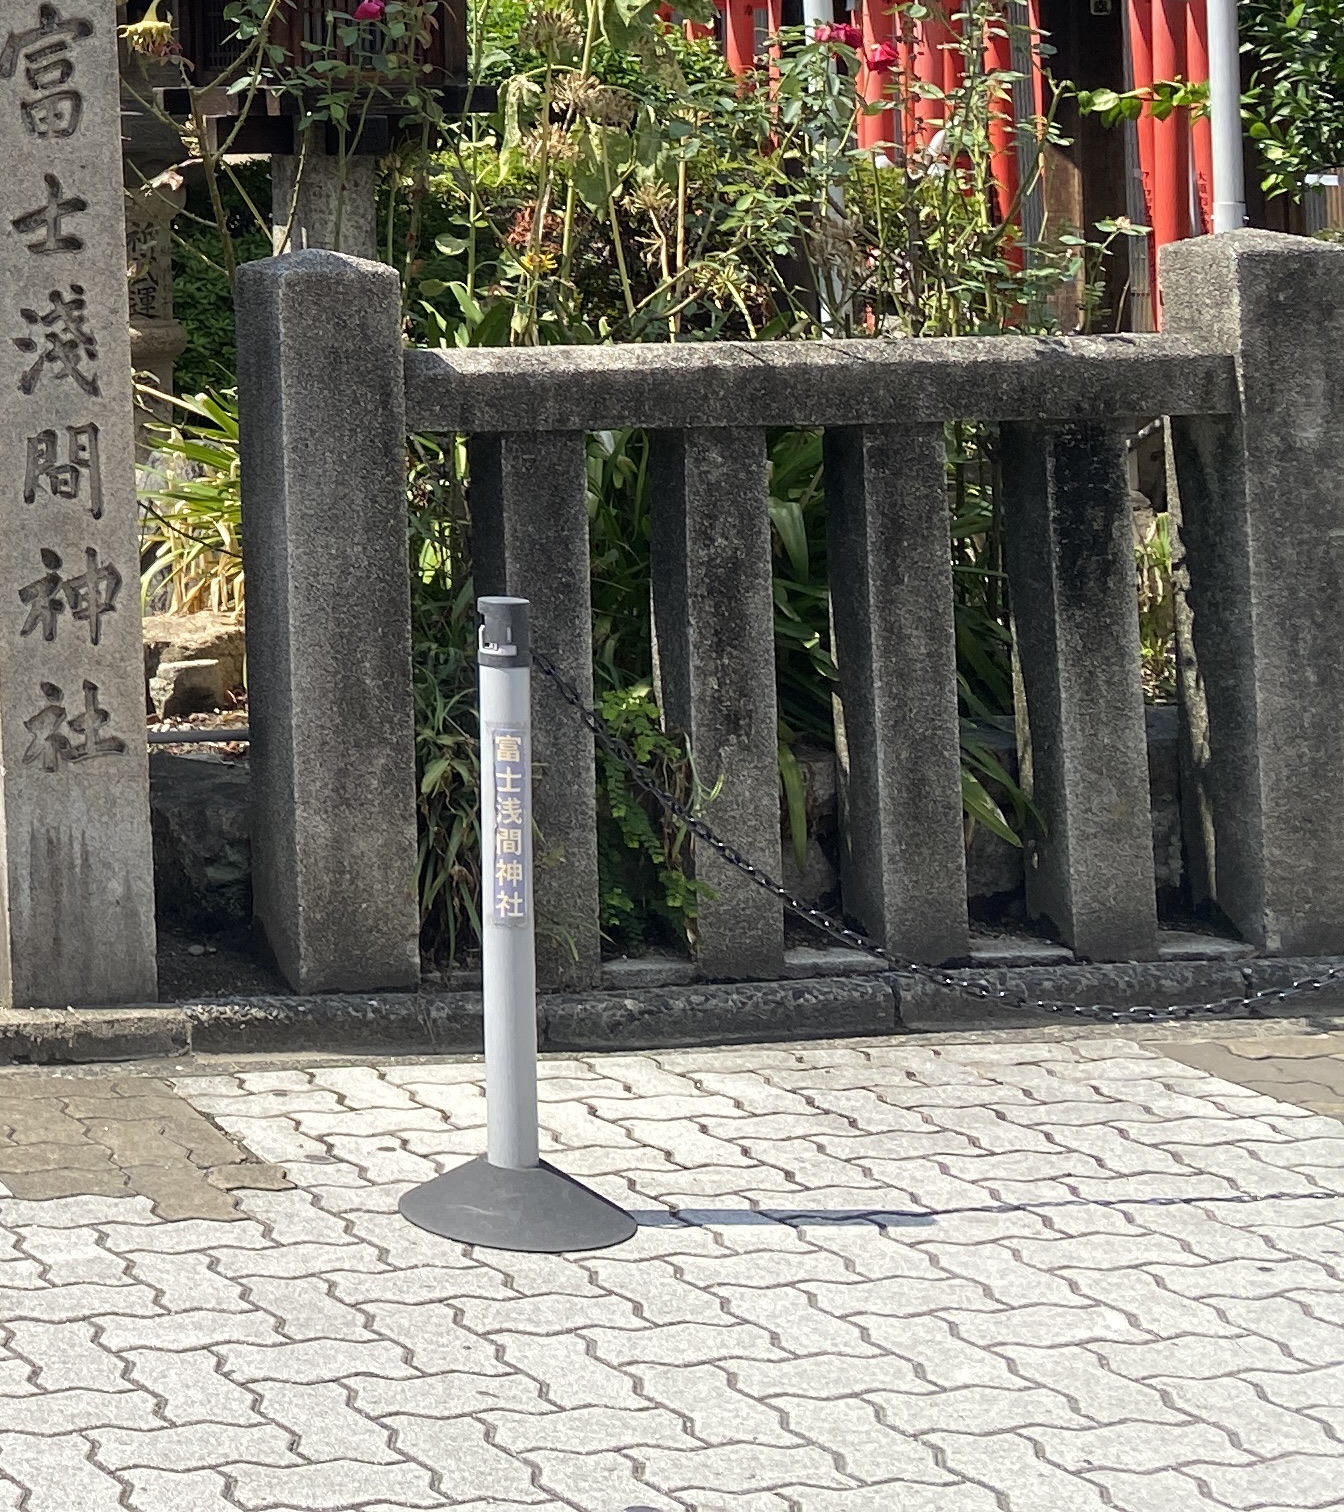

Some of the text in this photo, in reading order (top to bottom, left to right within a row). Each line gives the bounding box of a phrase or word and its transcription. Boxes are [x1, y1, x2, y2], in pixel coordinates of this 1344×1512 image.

[495, 735, 524, 918] 富士浅間神社
